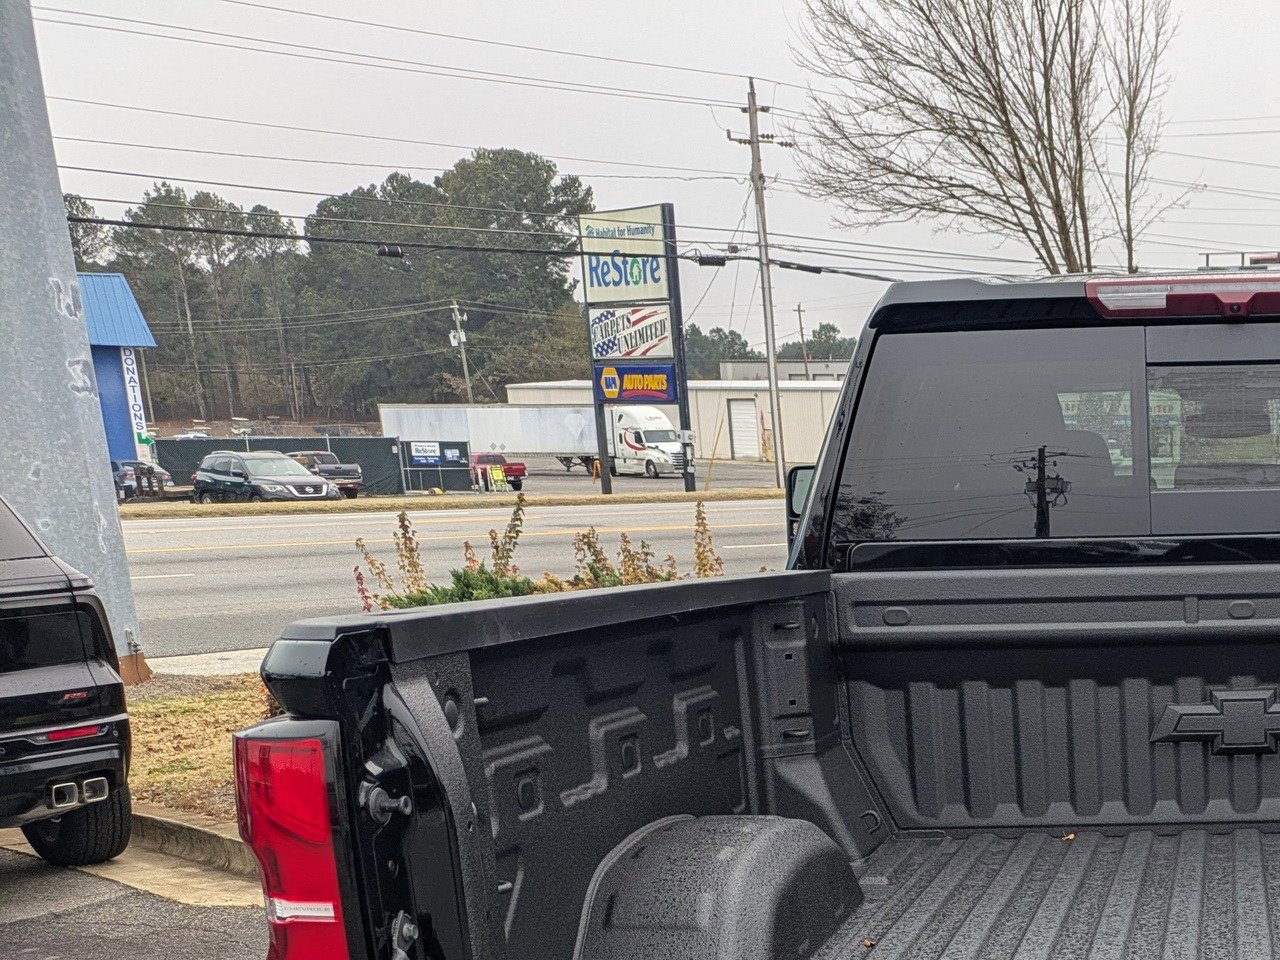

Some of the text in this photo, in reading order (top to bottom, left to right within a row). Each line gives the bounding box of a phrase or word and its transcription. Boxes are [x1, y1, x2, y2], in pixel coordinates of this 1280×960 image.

[595, 227, 616, 238] Habitat
[626, 224, 655, 237] Humanity
[588, 249, 662, 288] ReStore
[592, 311, 632, 345] CARPETS
[617, 318, 667, 355] UNLIMITED
[123, 348, 145, 431] DONATIONS
[622, 373, 644, 390] AUTO
[643, 373, 668, 391] PARTS
[63, 691, 89, 700] RS
